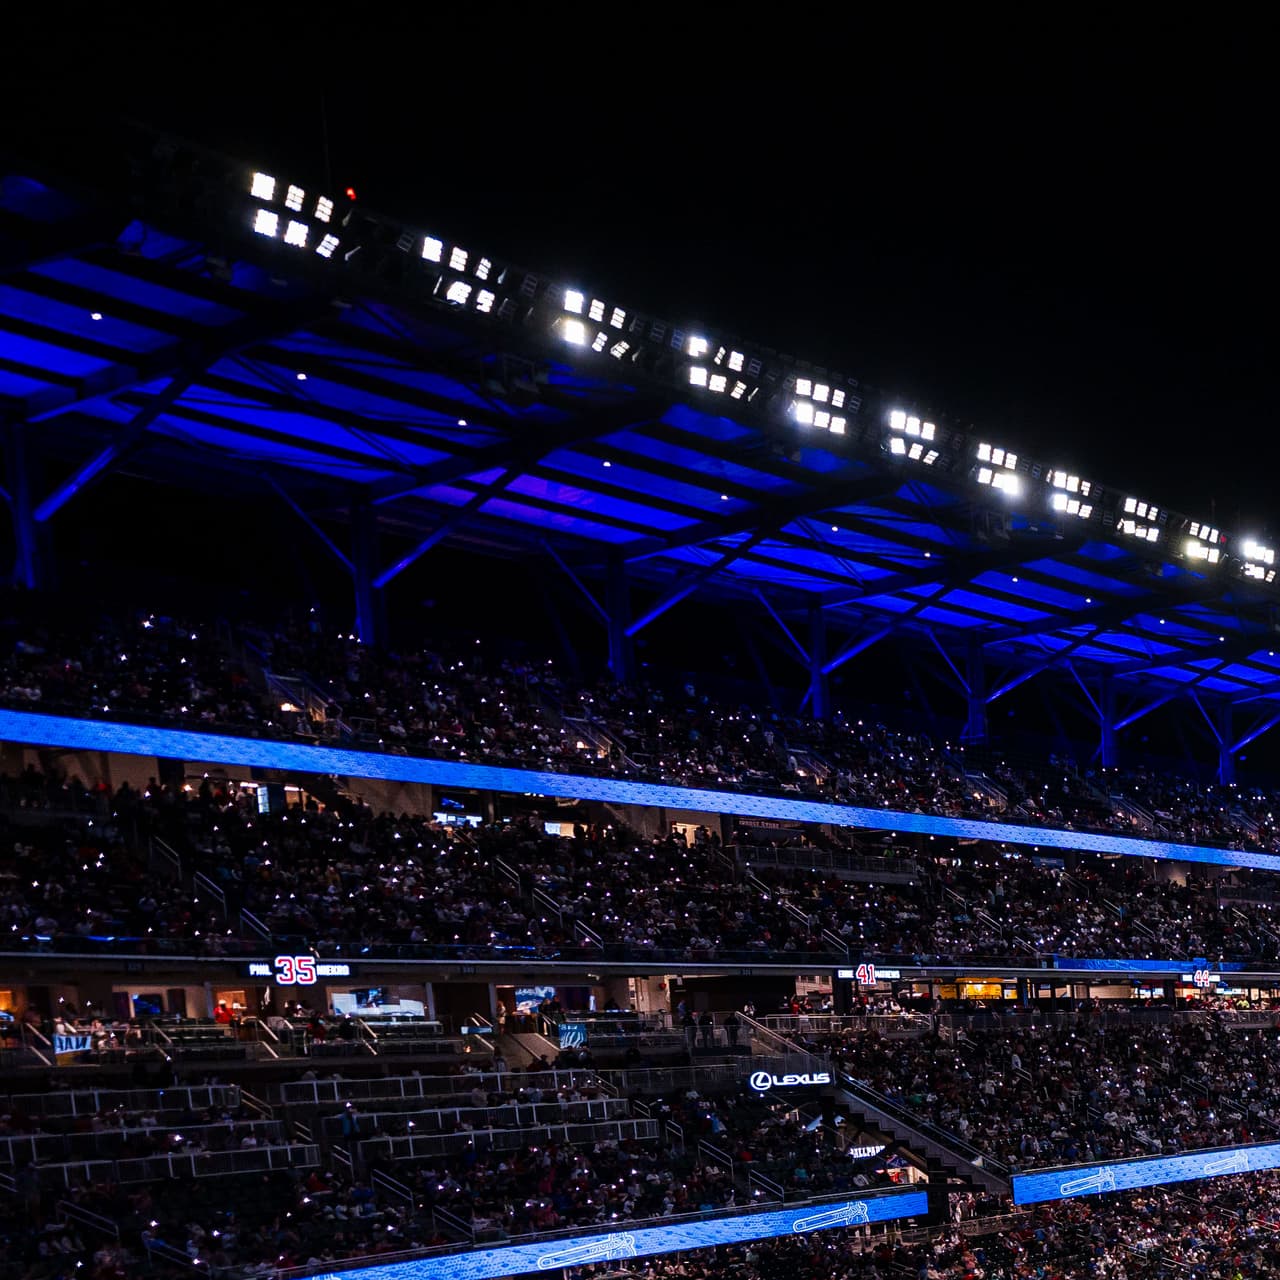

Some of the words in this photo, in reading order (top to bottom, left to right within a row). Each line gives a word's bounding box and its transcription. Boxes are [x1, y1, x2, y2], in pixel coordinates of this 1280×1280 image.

[274, 955, 317, 985] 35
[856, 964, 876, 985] 41
[1193, 970, 1210, 988] 44
[772, 1073, 831, 1086] LEXUS
